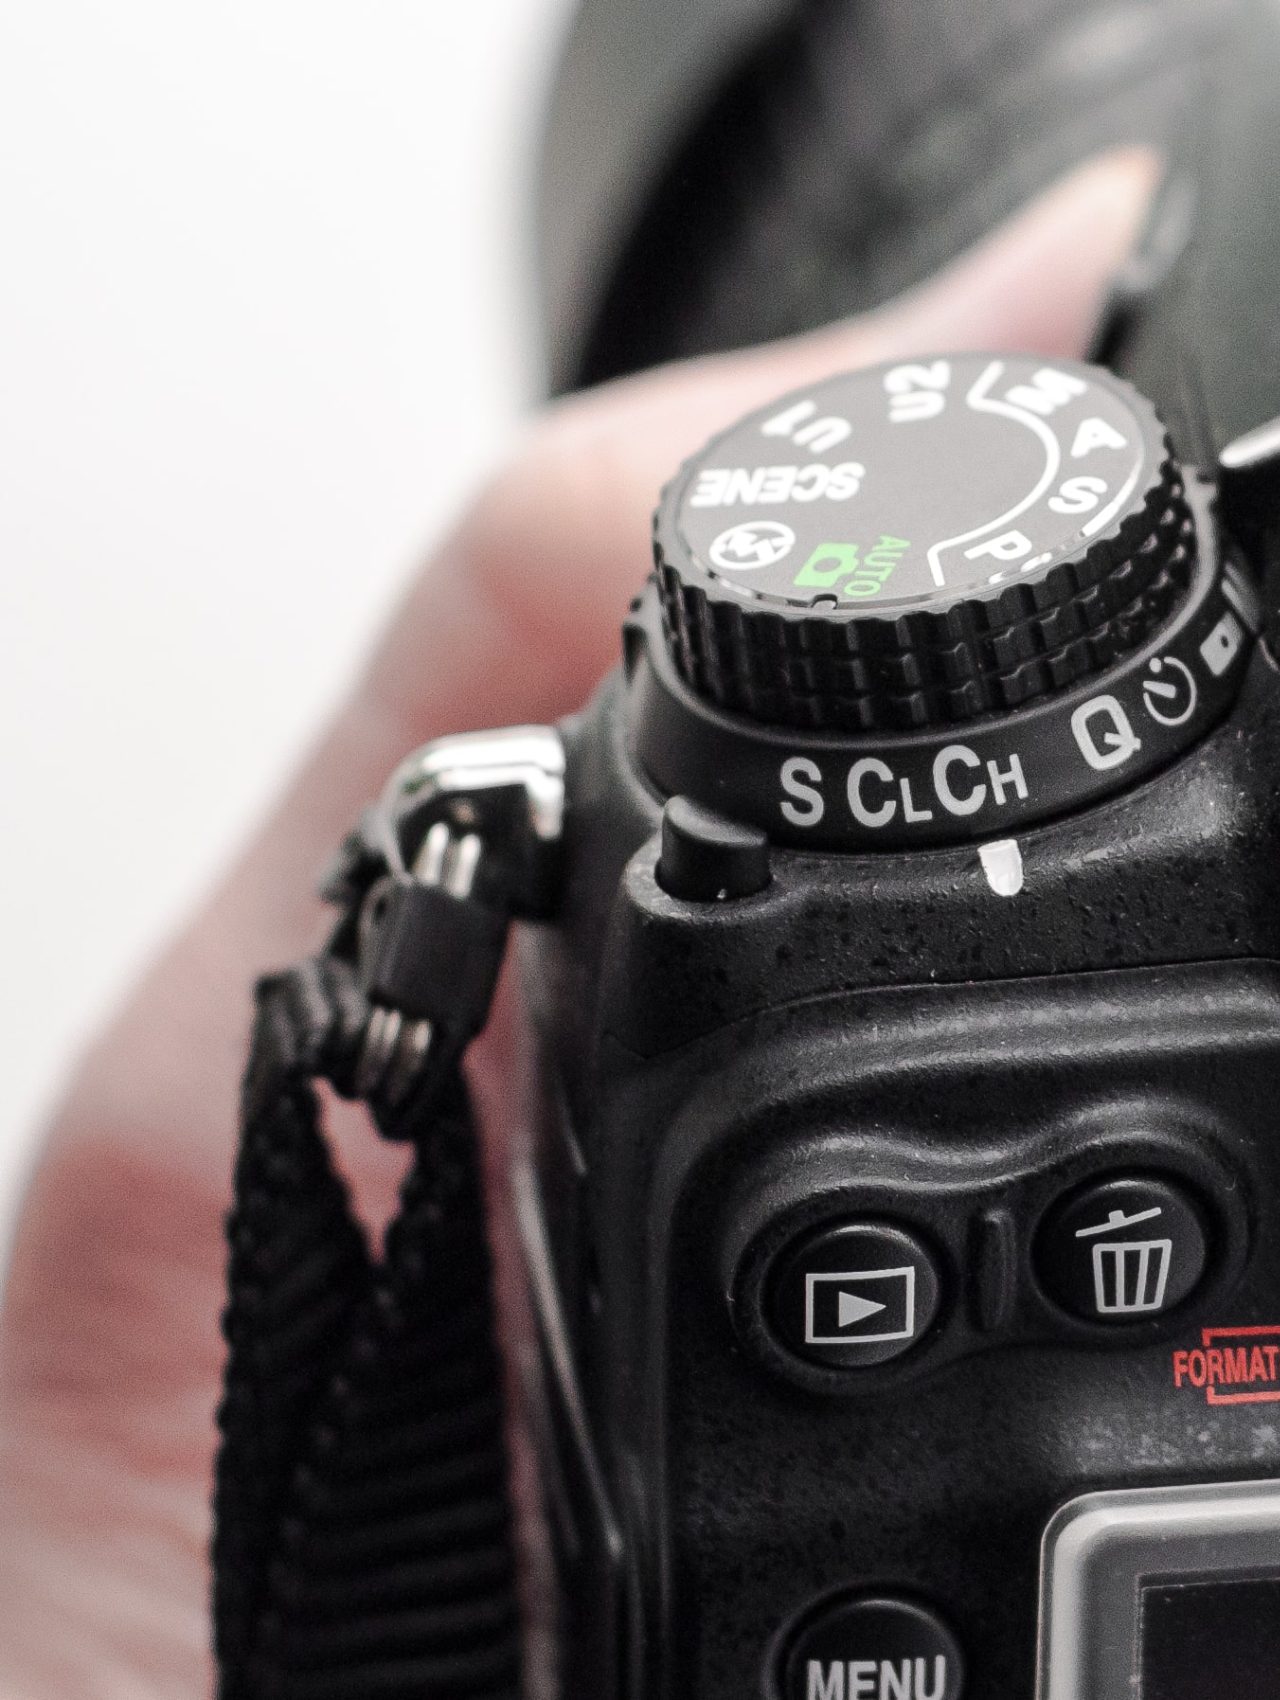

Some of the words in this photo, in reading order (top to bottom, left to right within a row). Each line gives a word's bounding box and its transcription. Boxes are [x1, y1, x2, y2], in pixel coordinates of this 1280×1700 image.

[884, 361, 950, 422] U2
[1005, 368, 1088, 415] M
[760, 400, 853, 453] U1
[1070, 417, 1127, 459] A
[690, 462, 866, 507] SCENE
[1048, 476, 1109, 514] S
[843, 534, 911, 597] AUTO
[963, 529, 1032, 561] P
[1071, 694, 1141, 770] Q
[780, 757, 824, 826] S
[1173, 1345, 1279, 1388] FORMAT
[807, 1654, 946, 1700] MENU
